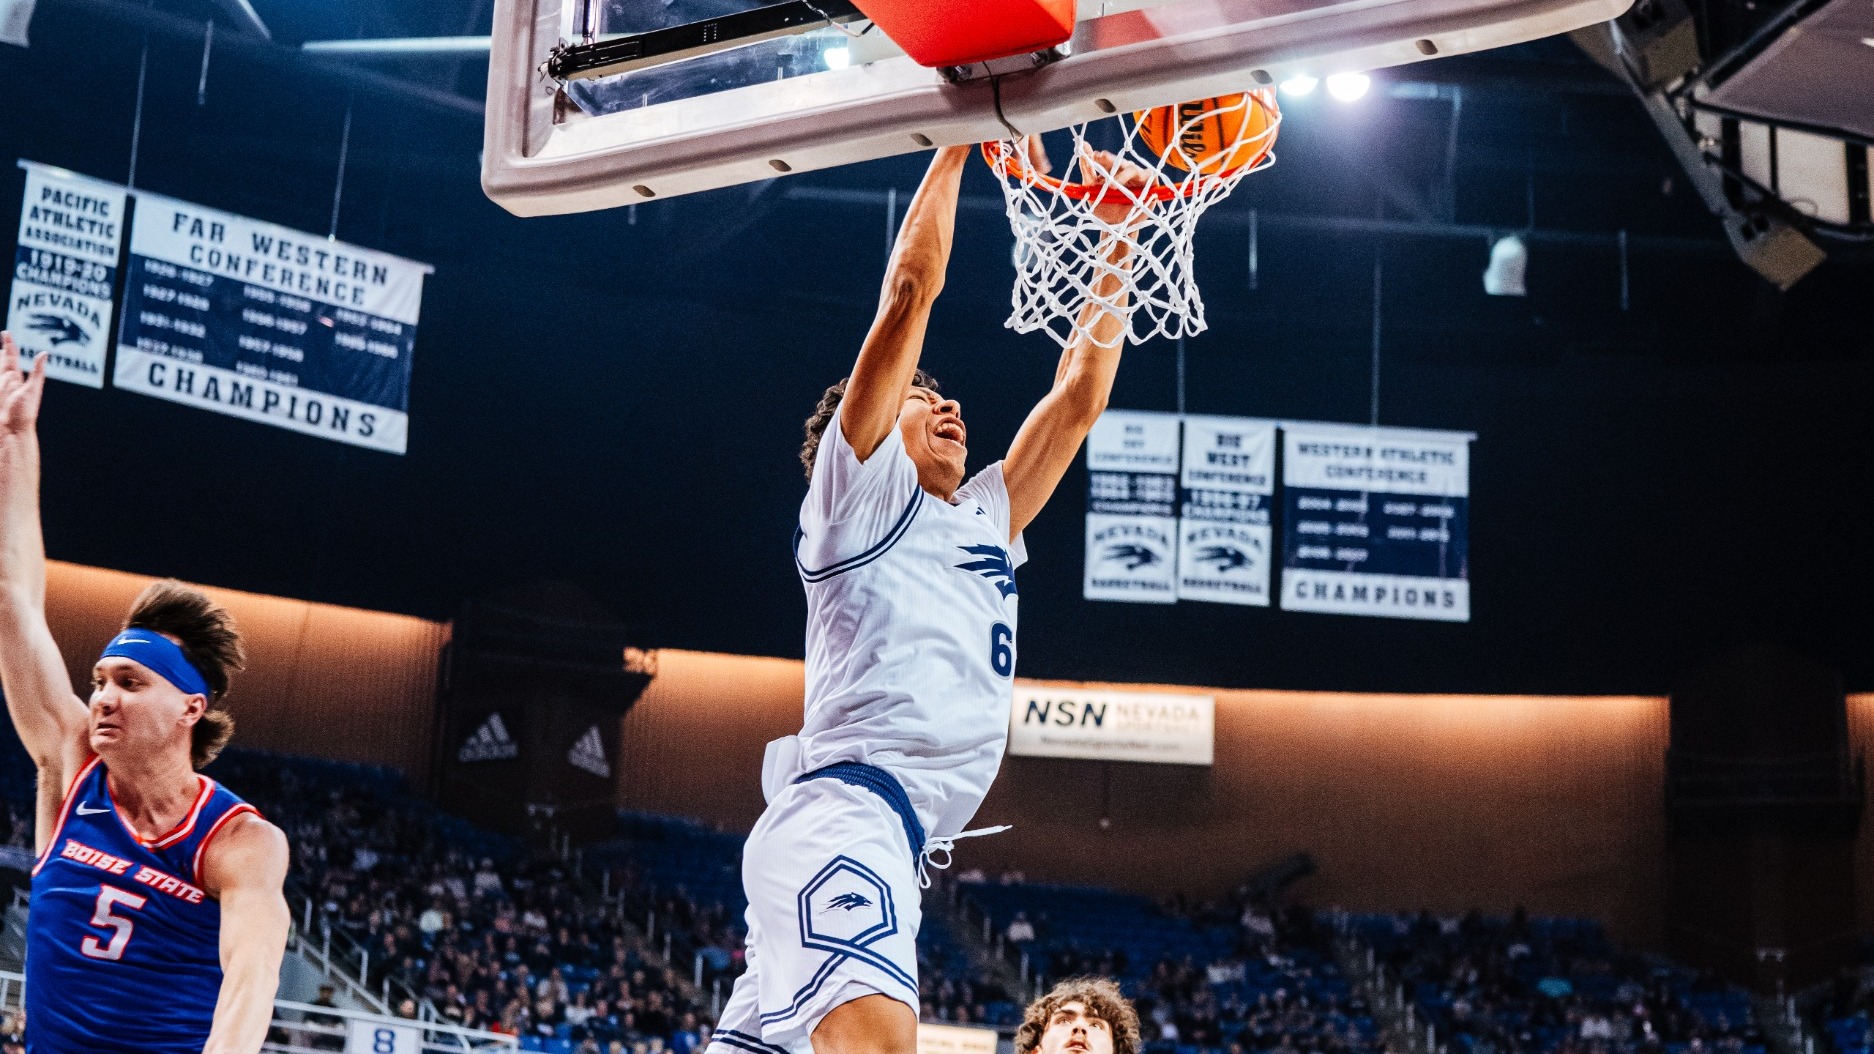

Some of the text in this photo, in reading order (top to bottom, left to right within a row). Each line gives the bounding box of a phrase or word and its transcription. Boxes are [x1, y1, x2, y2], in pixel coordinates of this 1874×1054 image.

[42, 186, 109, 216] PACIFIC
[30, 205, 115, 239] ATHLETIC
[25, 226, 115, 257] ASSOCIATION
[174, 212, 387, 285] FAR WESTERN
[16, 262, 112, 300] CHAMPIONS
[191, 244, 365, 306] CONFERENCE
[17, 293, 102, 328] NEVADA
[149, 362, 376, 438] CHAMPIONS
[1207, 452, 1250, 467] WEST
[1298, 443, 1455, 464] WESTERN ATHLETIC
[1326, 465, 1427, 482] CONFERENCE
[1095, 526, 1168, 546] NEVADA
[1188, 528, 1262, 549] NEVADA
[1296, 582, 1455, 608] CHAMPIONS
[989, 620, 1014, 680] 6
[1025, 700, 1199, 727] NSN NEVADA
[60, 838, 205, 904] BOISE STATE
[81, 882, 147, 961] 5
[373, 1028, 395, 1054] 8
